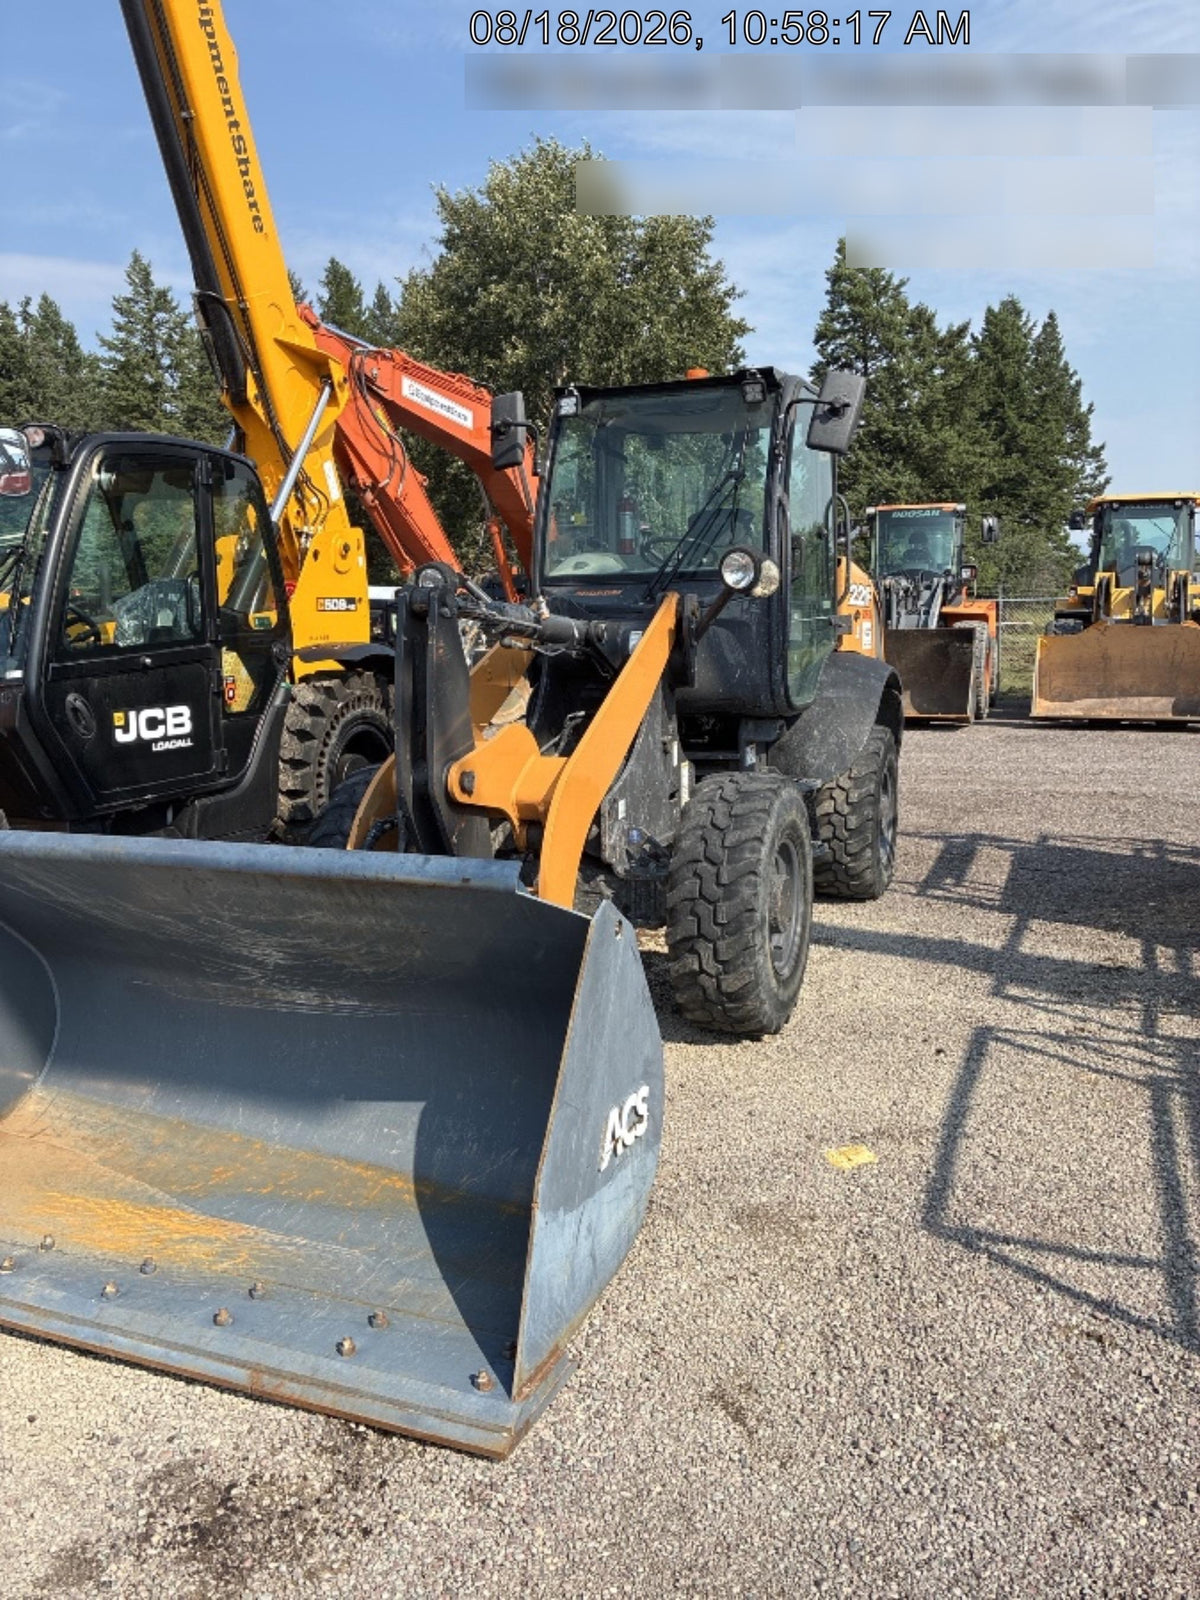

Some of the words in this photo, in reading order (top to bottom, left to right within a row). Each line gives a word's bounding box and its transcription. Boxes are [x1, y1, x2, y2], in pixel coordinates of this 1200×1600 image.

[113, 705, 193, 743] JCB
[151, 738, 195, 752] LOADALL
[599, 1085, 650, 1173] ACS
